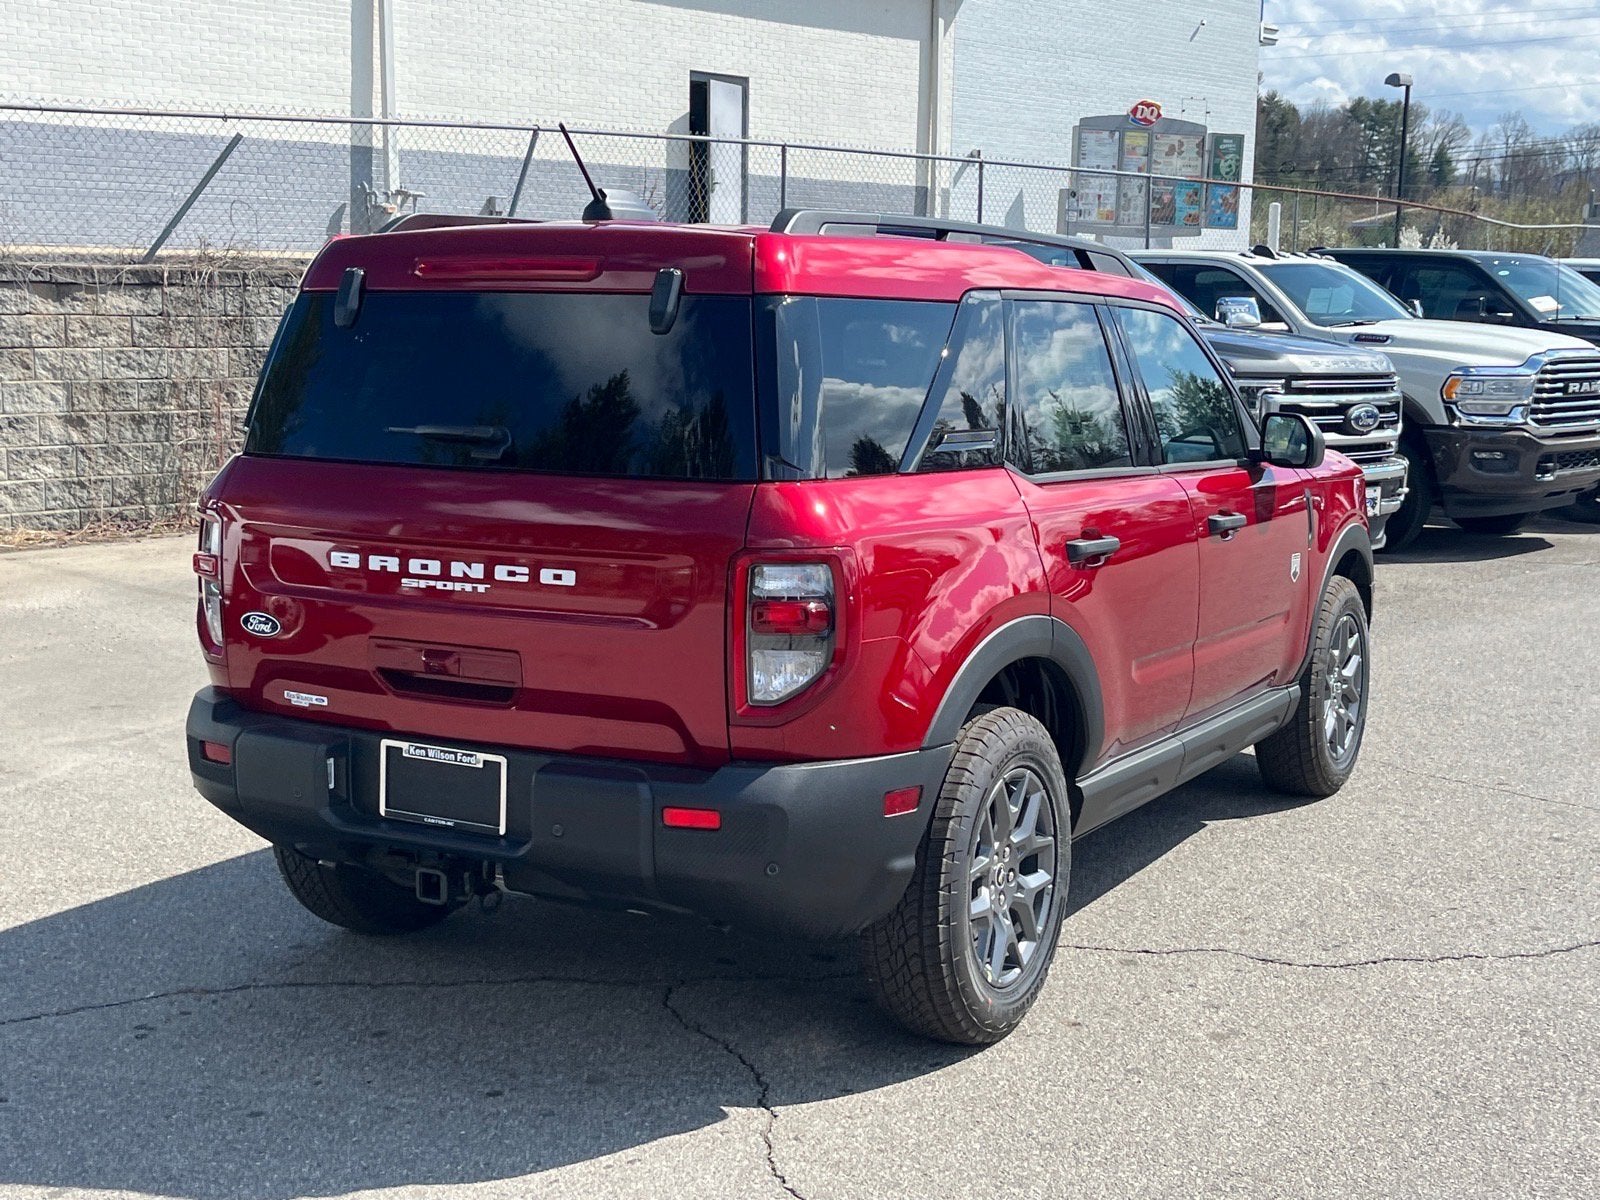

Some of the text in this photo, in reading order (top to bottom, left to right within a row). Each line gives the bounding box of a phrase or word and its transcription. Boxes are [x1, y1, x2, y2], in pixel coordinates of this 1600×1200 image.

[1136, 105, 1158, 121] DQ
[1567, 382, 1600, 394] RAM
[330, 551, 576, 587] BRONCO
[401, 578, 491, 593] SPORT
[409, 745, 476, 764] Ken Wilson Ford
